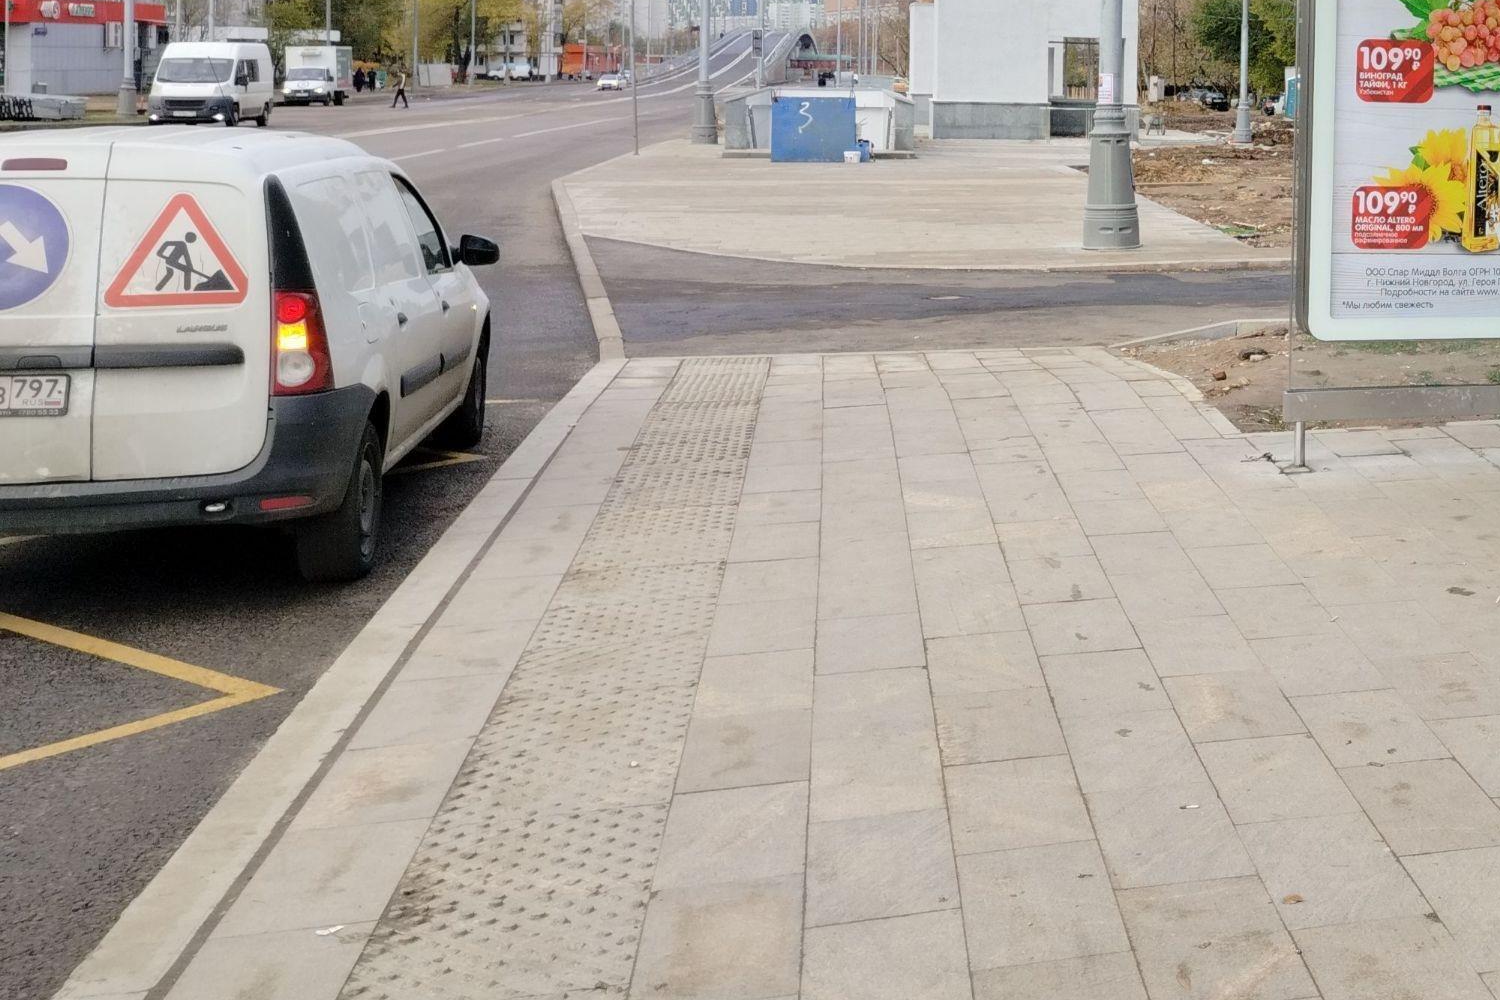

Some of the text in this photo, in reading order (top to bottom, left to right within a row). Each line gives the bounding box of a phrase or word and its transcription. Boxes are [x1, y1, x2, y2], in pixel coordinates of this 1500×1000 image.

[1360, 72, 1403, 81] ВИНОГРАД
[1359, 80, 1391, 89] ТАЙФИ,
[1398, 81, 1408, 89] КГ
[1476, 160, 1488, 211] Altero
[1365, 267, 1385, 276] ООО
[1387, 268, 1409, 277] Спар
[1411, 268, 1440, 277] Миддл
[1442, 268, 1467, 276] Волга
[1469, 268, 1491, 276] ОГРН
[1376, 278, 1410, 286] Нижний
[1472, 278, 1496, 287] Героя
[1380, 288, 1437, 297] Подробности
[1451, 287, 1475, 296] сайте
[1363, 301, 1392, 309] любим
[1395, 301, 1434, 309] свежесть
[176, 324, 228, 333] LARGUS
[14, 378, 59, 398] 797
